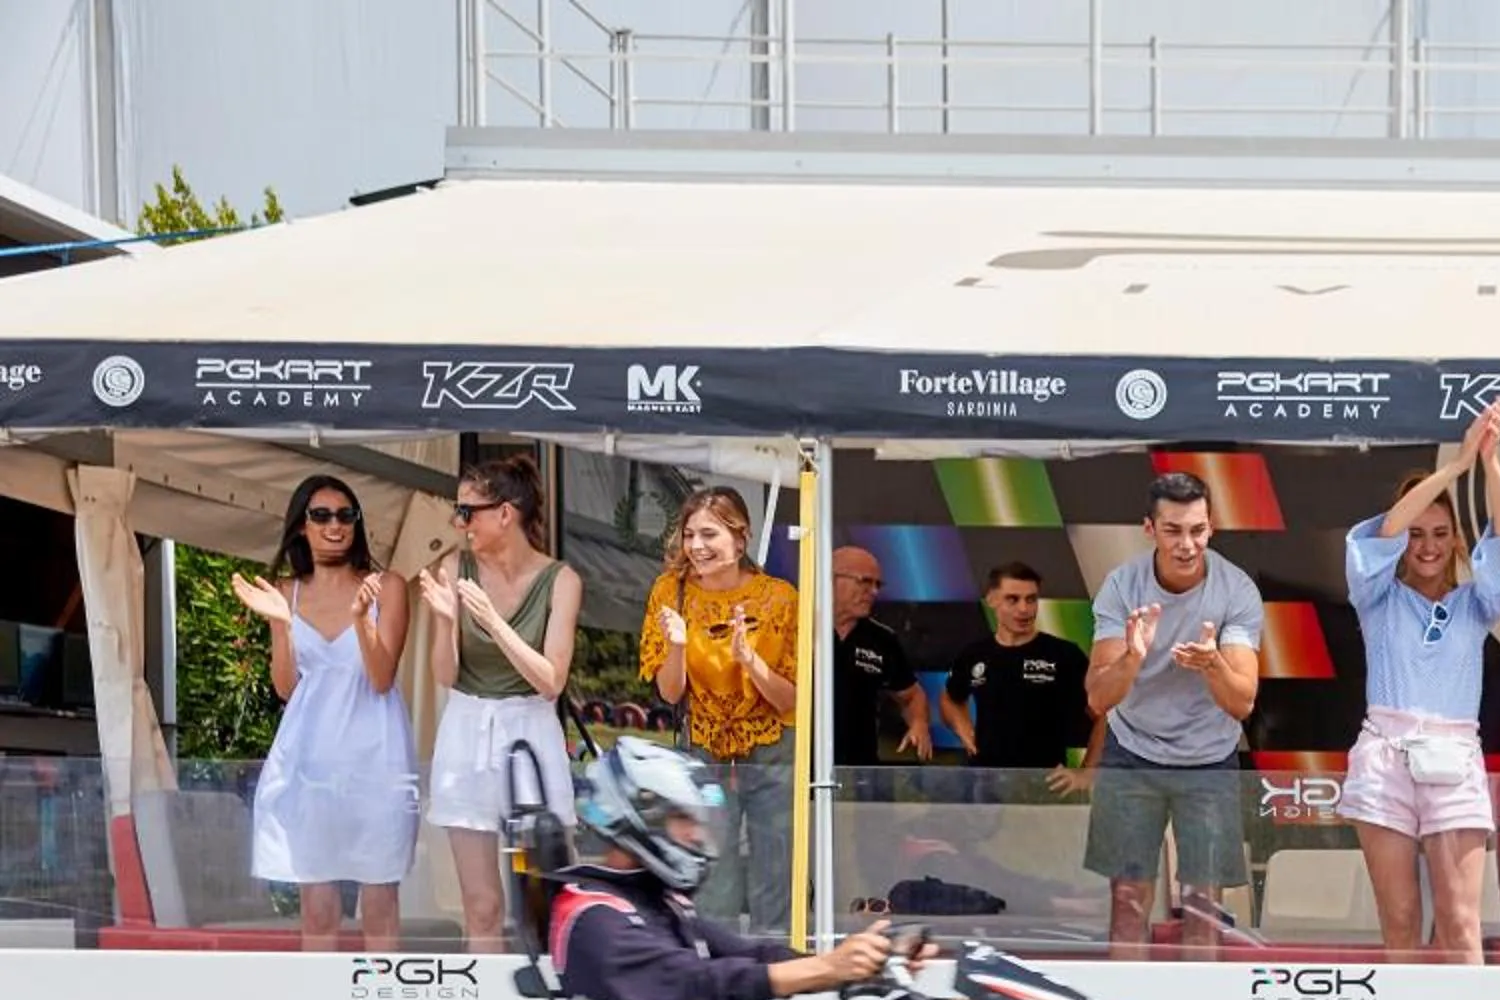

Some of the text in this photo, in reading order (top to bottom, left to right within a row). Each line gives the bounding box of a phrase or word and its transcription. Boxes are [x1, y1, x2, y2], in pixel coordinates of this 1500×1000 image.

[196, 358, 372, 381] PGKART
[421, 362, 577, 411] KZR
[627, 364, 702, 400] MK
[899, 369, 1068, 402] ForteVillage
[1217, 372, 1391, 393] PGKART
[203, 391, 362, 407] ACADEMY
[947, 402, 1017, 417] SARDINIA
[1224, 403, 1381, 419] ACADEMY
[352, 958, 477, 984] PGK
[1251, 969, 1377, 995] PGK
[351, 987, 479, 999] DESIGN
